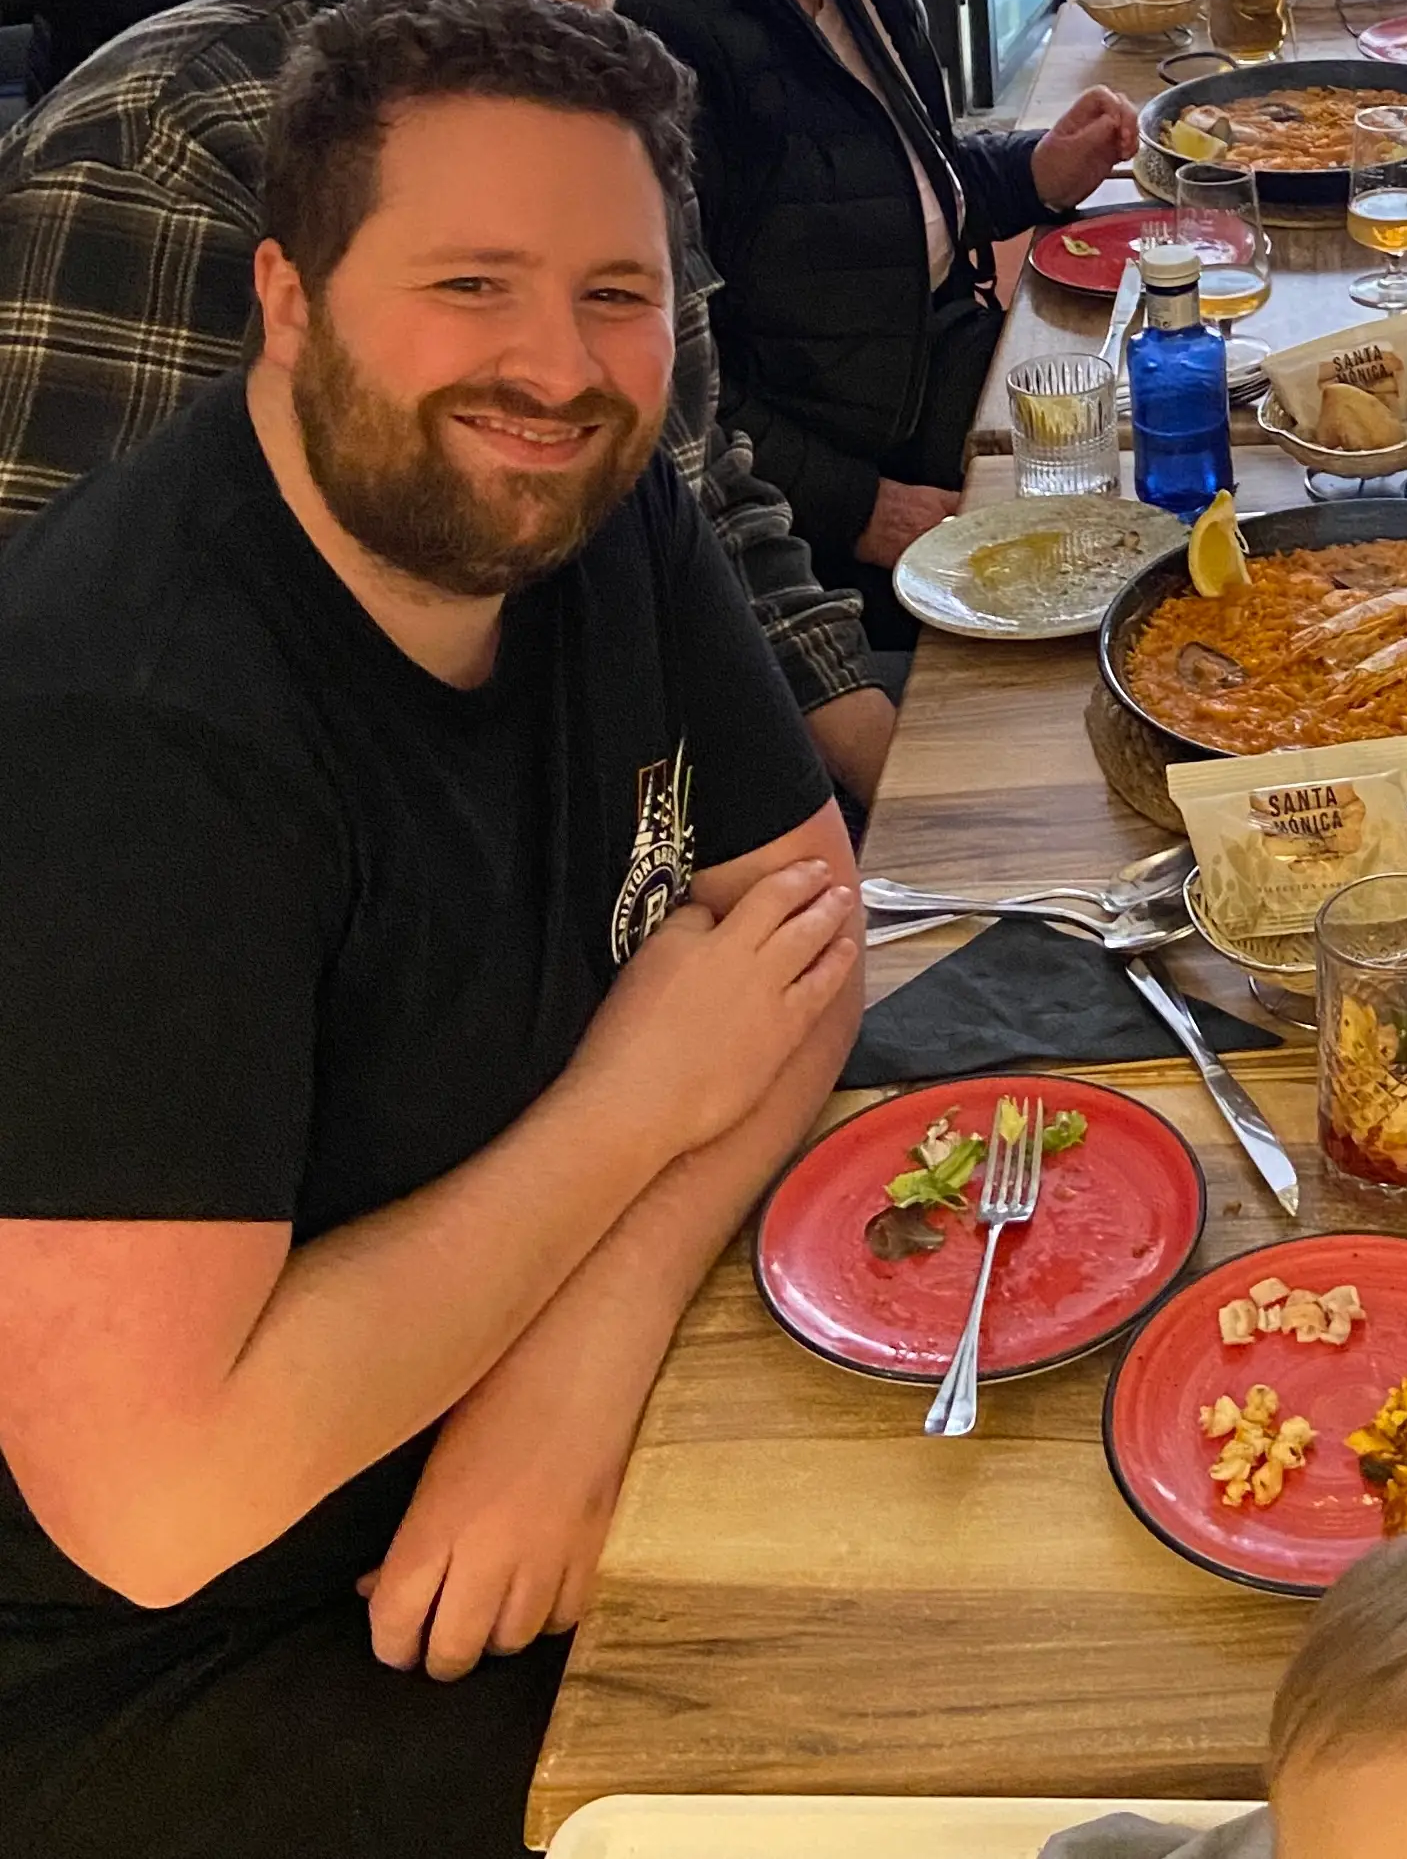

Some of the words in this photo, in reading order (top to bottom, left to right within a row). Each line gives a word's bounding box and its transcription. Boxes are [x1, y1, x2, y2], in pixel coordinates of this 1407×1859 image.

[1332, 345, 1384, 372] SANTA
[1268, 785, 1338, 818] SANTA
[1273, 810, 1344, 835] MÓNICA
